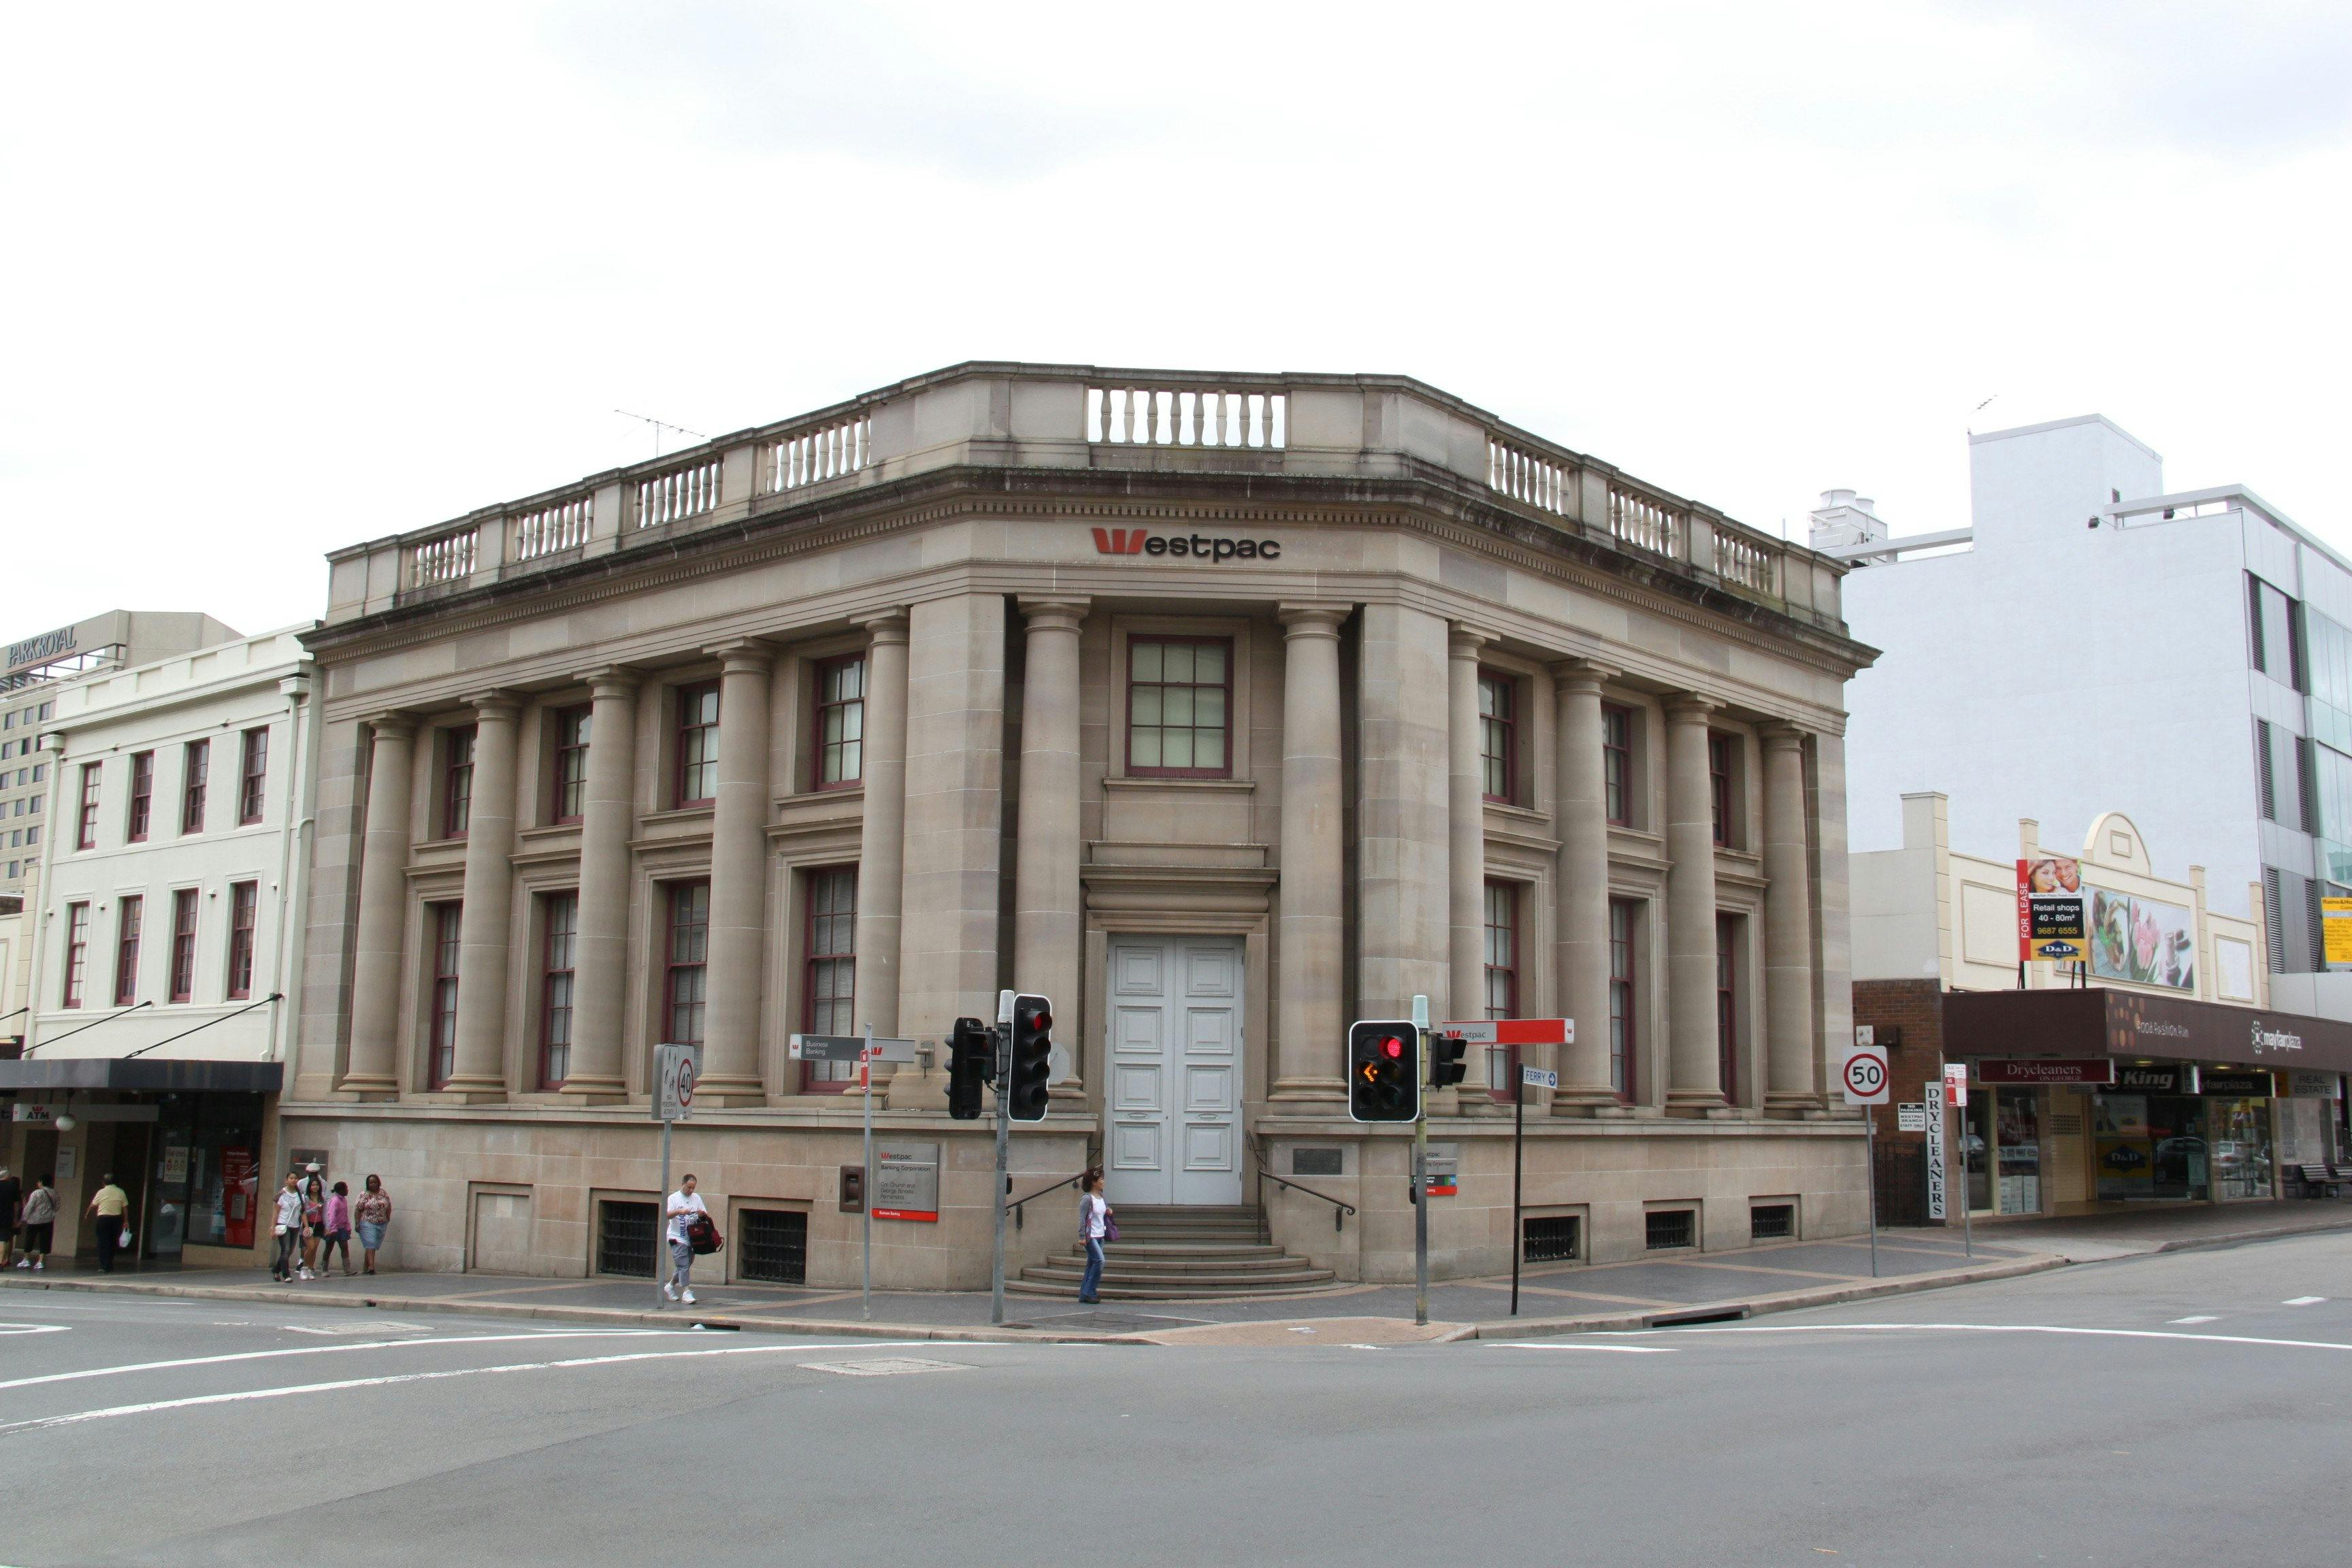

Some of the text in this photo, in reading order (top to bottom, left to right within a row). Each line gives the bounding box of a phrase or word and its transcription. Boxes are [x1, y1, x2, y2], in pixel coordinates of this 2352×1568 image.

[1092, 527, 1281, 564] Westpac
[6, 625, 78, 668] PARKROYAL
[2019, 882, 2029, 938] FOR LEASE
[2057, 904, 2080, 913] shops
[1446, 1030, 1486, 1039] Westpac
[1526, 1070, 1546, 1082] FERRY
[1852, 1066, 1880, 1085] 50
[2008, 1063, 2082, 1077] Drycleaners
[681, 1073, 691, 1094] 40
[2123, 1071, 2174, 1089] King
[2298, 1075, 2326, 1083] REAL
[2295, 1085, 2332, 1094] ESTATE
[27, 1105, 50, 1120] ATM
[881, 1152, 913, 1160] Westpac
[1927, 1088, 1943, 1215] DRYCLEANERS
